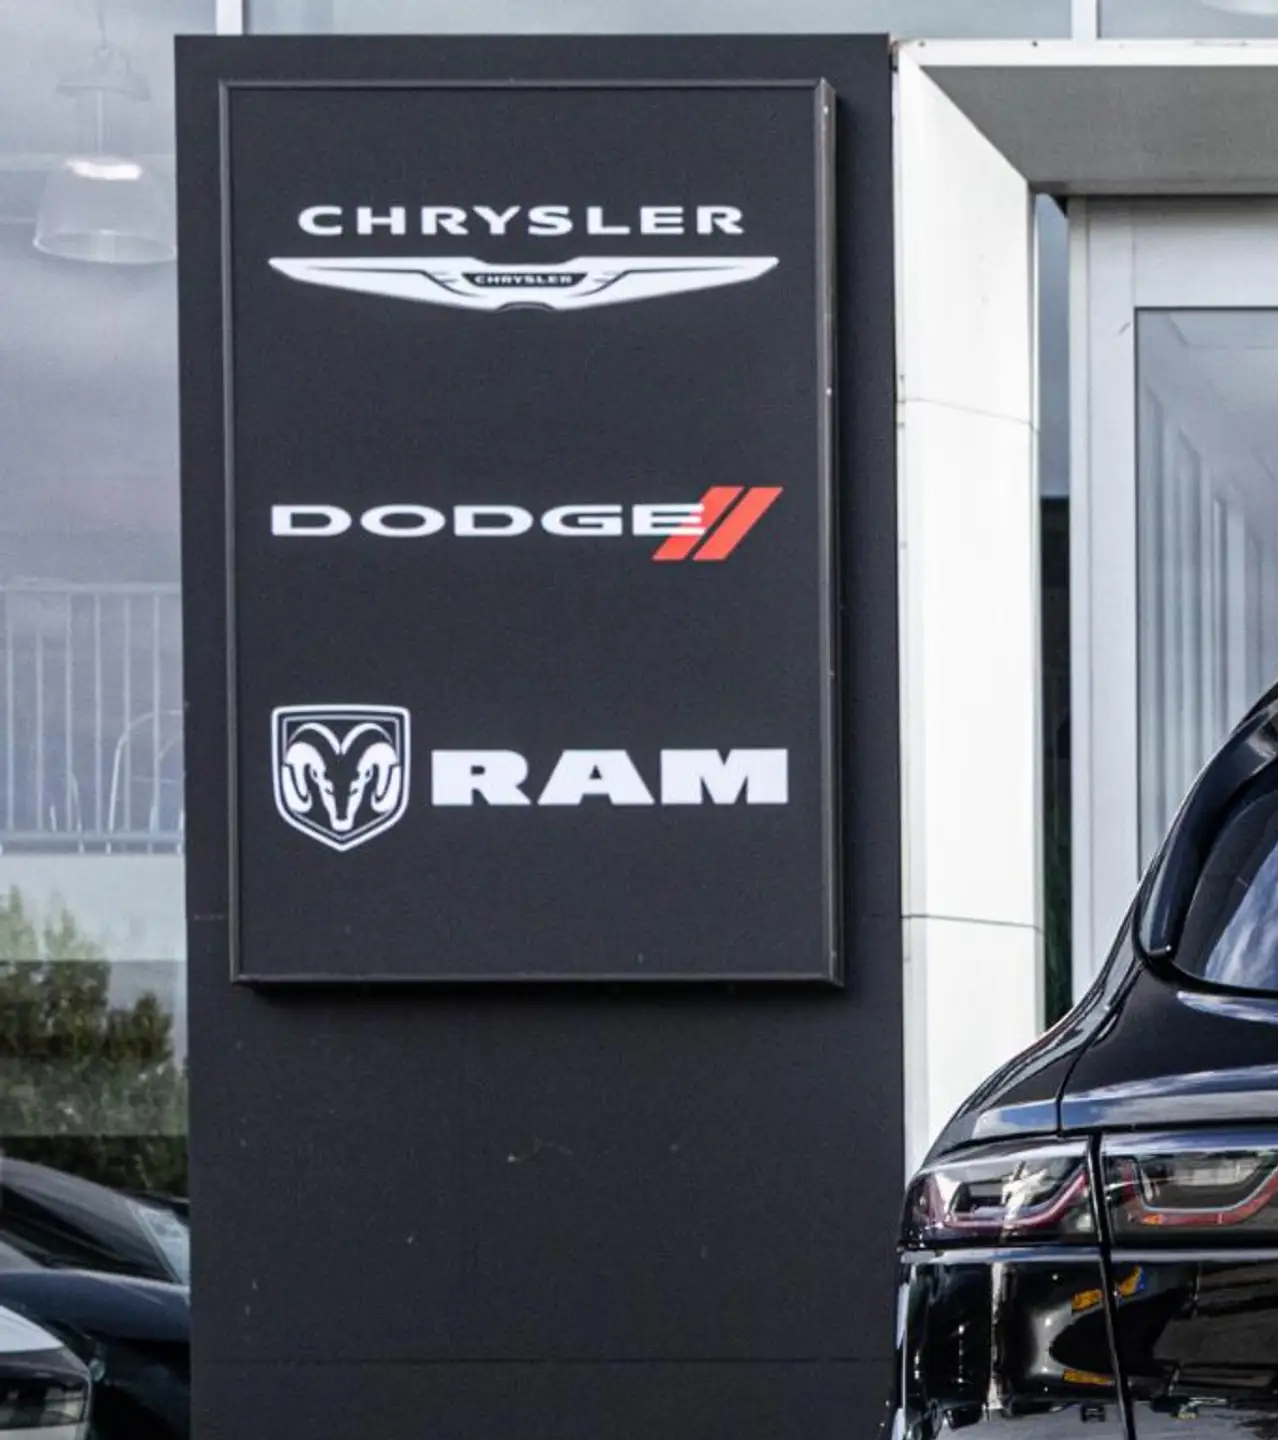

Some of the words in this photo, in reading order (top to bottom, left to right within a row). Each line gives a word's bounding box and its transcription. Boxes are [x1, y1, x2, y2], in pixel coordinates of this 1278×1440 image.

[298, 205, 744, 236] CHRYSLER
[474, 275, 573, 285] CHRYSLER
[271, 503, 706, 537] DODGE
[431, 748, 789, 806] RAM
